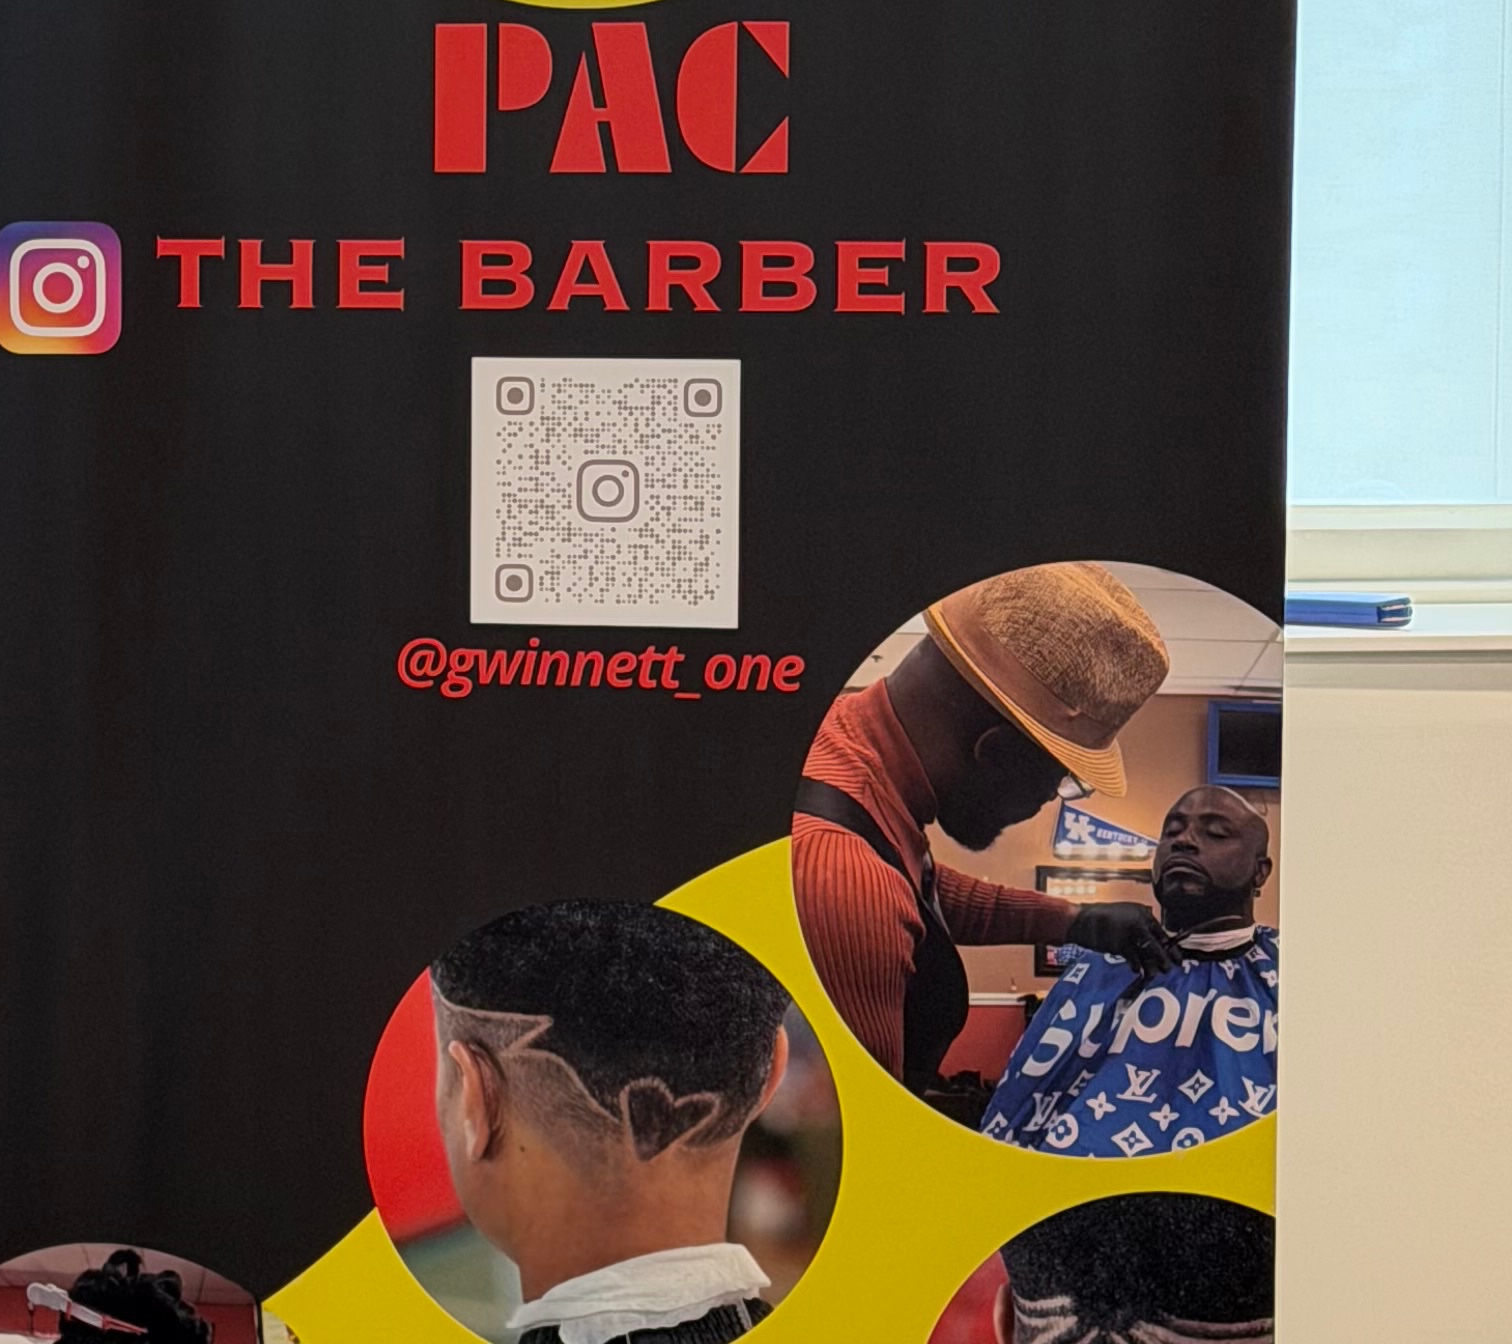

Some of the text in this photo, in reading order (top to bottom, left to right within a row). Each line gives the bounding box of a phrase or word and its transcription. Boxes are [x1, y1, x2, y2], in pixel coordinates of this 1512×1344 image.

[433, 21, 790, 174] PAC
[155, 235, 1004, 315] THE BARBER
[395, 636, 806, 700] @gwinnett_one
